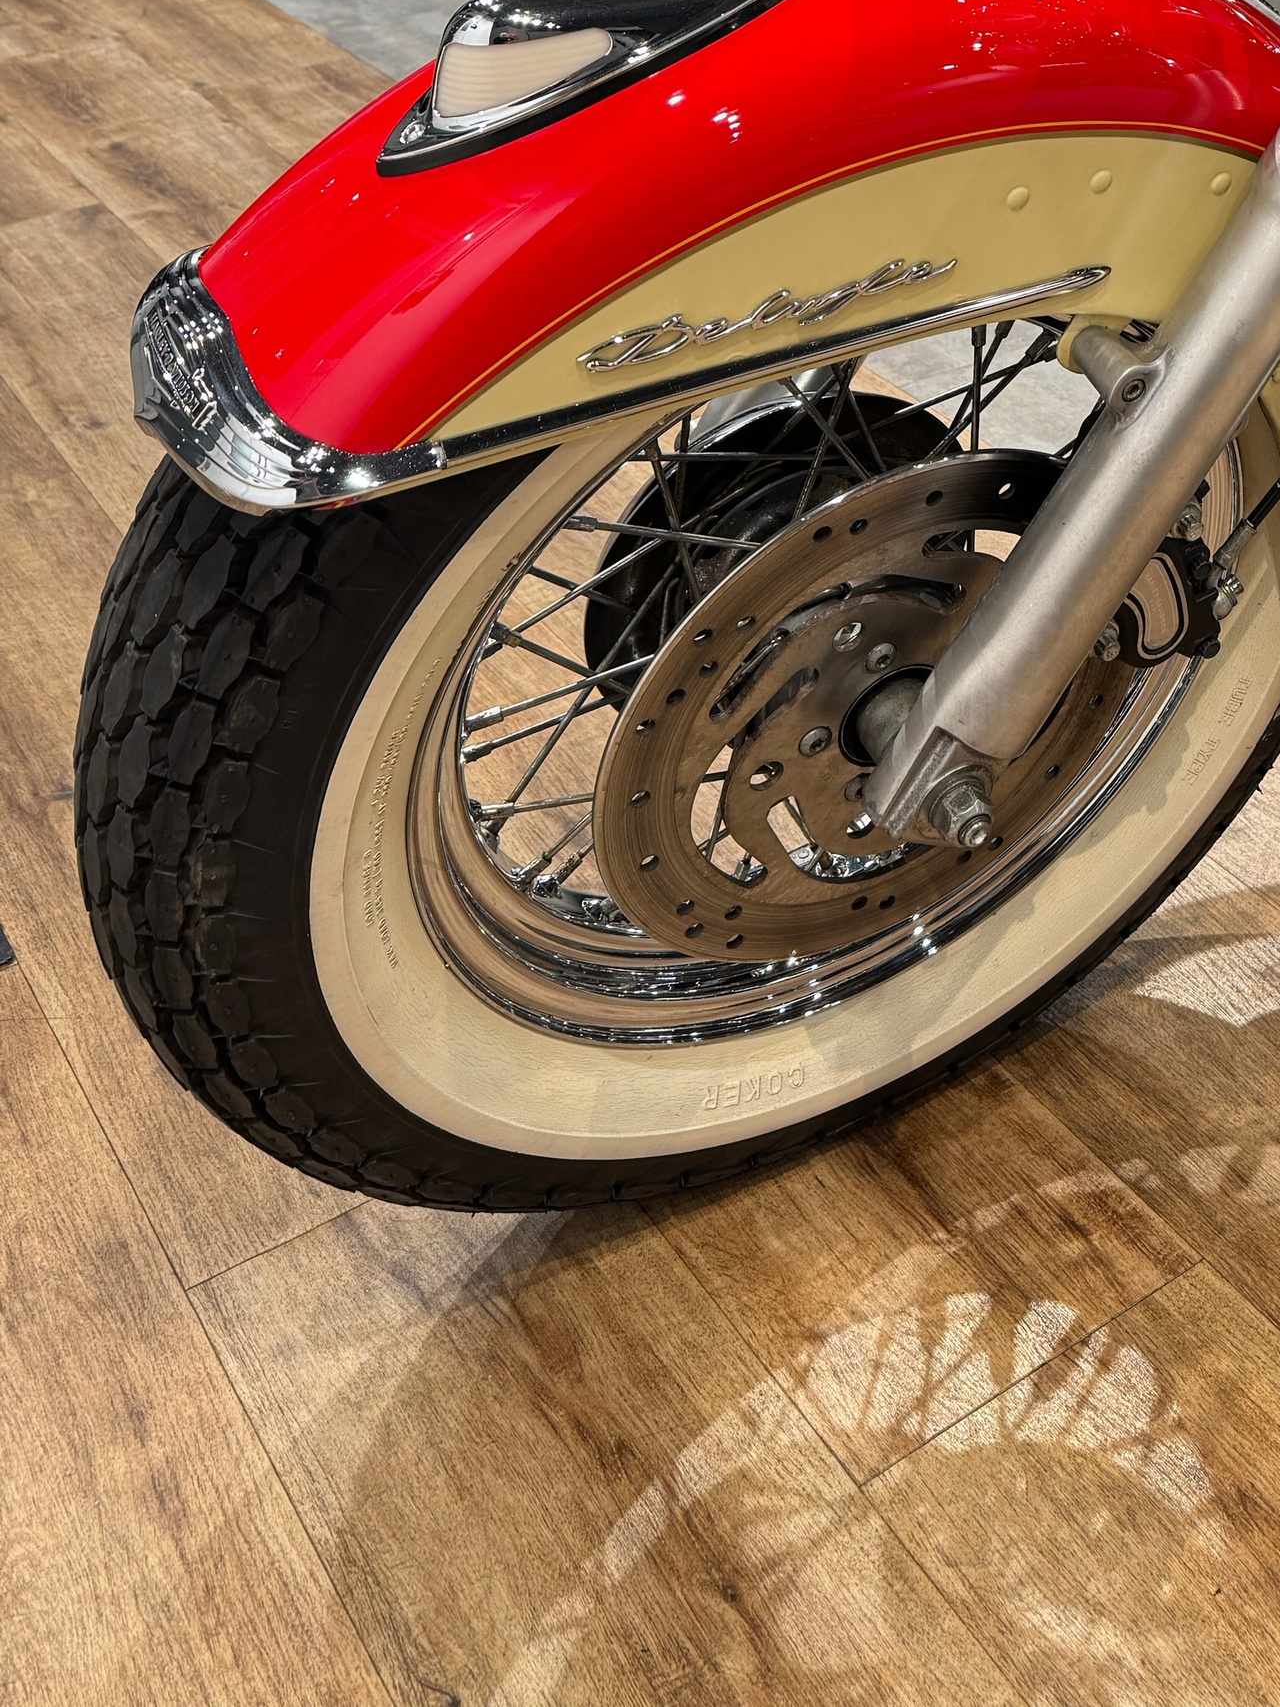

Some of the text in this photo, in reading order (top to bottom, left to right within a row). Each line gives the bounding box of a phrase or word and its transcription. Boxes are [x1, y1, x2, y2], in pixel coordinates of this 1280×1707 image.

[577, 259, 957, 372] Deluxe
[1185, 676, 1254, 787] TUBE TYPE
[702, 1062, 807, 1111] COKER
